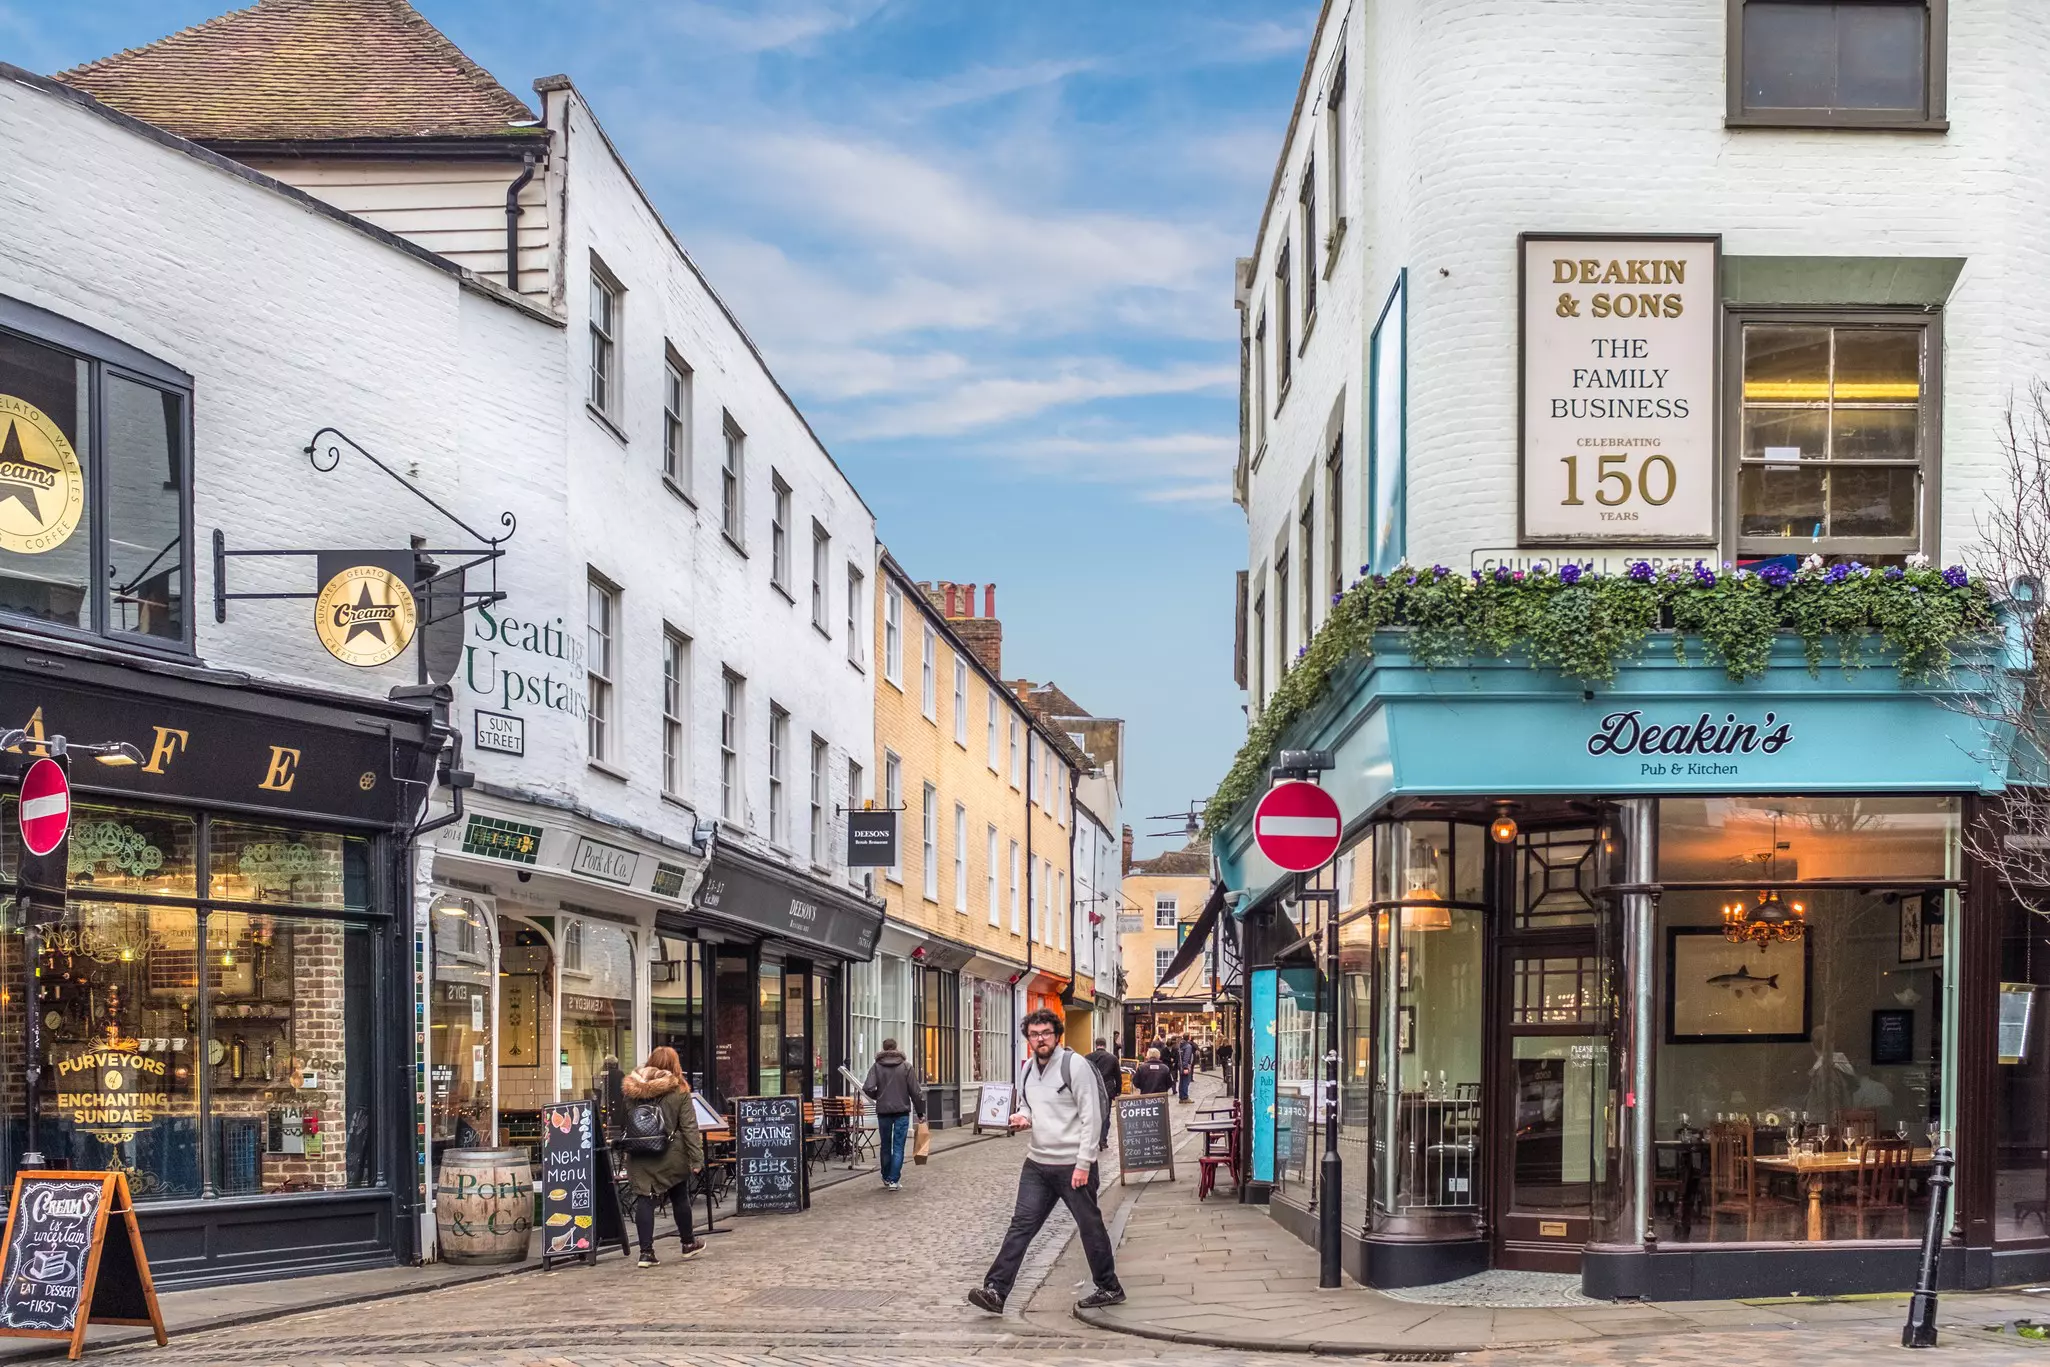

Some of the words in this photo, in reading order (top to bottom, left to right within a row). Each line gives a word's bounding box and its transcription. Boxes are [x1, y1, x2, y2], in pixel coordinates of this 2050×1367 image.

[1552, 259, 1687, 285] DEAKIN
[1555, 292, 1581, 318] &
[1591, 292, 1684, 319] SONS
[1591, 338, 1649, 359] THE
[1572, 368, 1669, 389] FAMILY
[1550, 398, 1690, 419] BUSINESS
[1576, 437, 1661, 447] CELEBRATING
[55, 434, 81, 504] WAFFLES
[1560, 452, 1677, 507] 150
[1599, 512, 1640, 521] YEARS
[25, 520, 71, 550] COFFEE
[318, 582, 337, 624] SUNDAES
[346, 569, 384, 578] GELATO
[395, 582, 414, 624] WAFFLES
[333, 603, 395, 628] Creams
[326, 638, 358, 662] CREPES
[475, 602, 585, 680] Seating
[465, 645, 587, 722] Upstairs
[490, 717, 512, 733] SUN
[1587, 709, 1794, 757] Deakin's
[479, 730, 521, 750] STREET
[1641, 763, 1667, 776] Pub
[1671, 763, 1684, 776] &
[1688, 763, 1738, 776] Kitchen
[442, 828, 462, 841] 2014
[581, 845, 604, 872] Pork
[604, 851, 613, 874] &
[613, 854, 627, 878] Co.
[58, 1053, 166, 1076] PURVEYORS
[1260, 1076, 1274, 1086] Pub
[57, 1093, 168, 1108] ENCHANTING
[74, 1109, 153, 1124] SUNDAES
[1121, 1107, 1159, 1118] COFFEE
[744, 1126, 792, 1141] SEATING
[1122, 1138, 1141, 1147] OPEN
[455, 1173, 527, 1200] Pork
[32, 1190, 96, 1223] CREAMS
[34, 1223, 86, 1244] uncertain
[49, 1220, 62, 1231] is
[452, 1212, 479, 1239] &
[20, 1283, 37, 1296] EAT
[45, 1284, 77, 1299] DESSERT
[29, 1300, 56, 1313] FIRST
